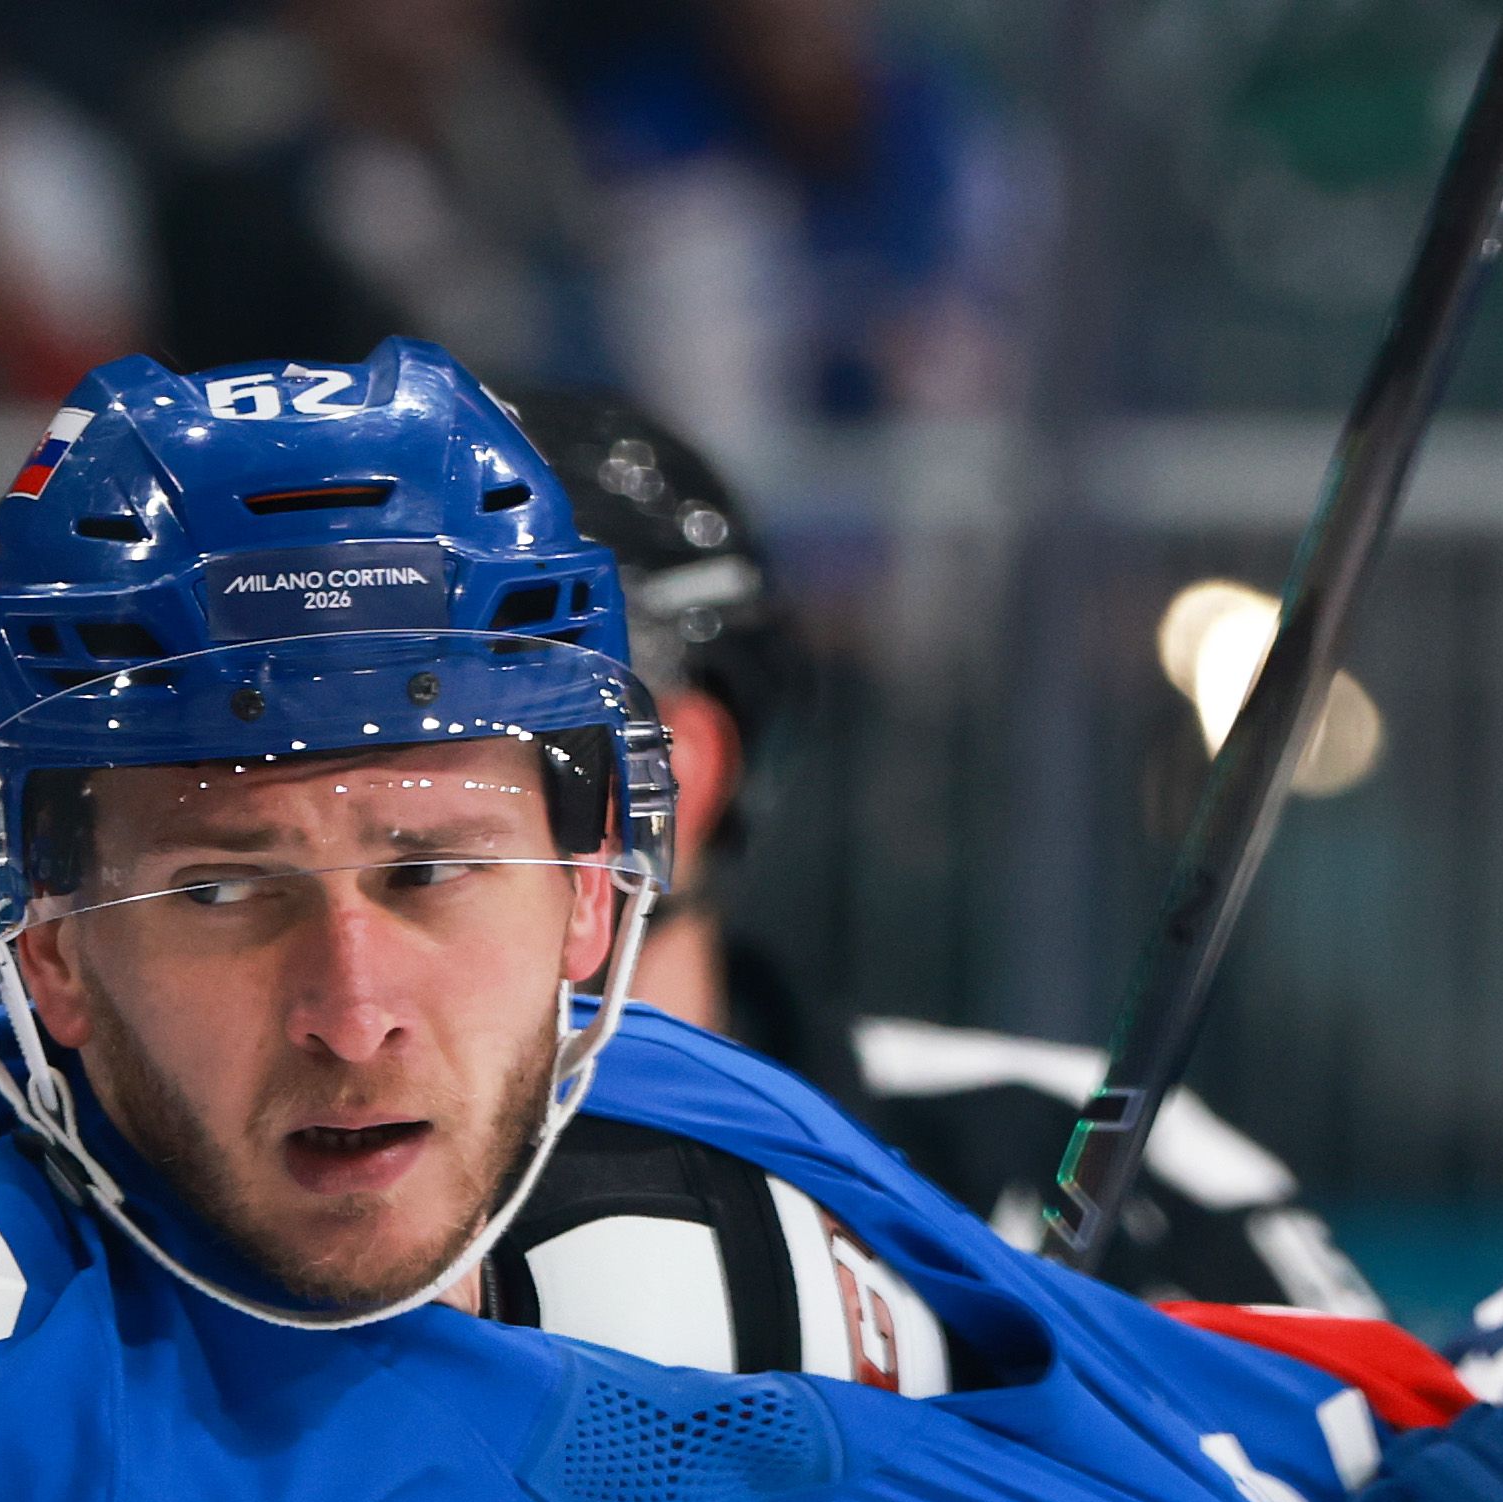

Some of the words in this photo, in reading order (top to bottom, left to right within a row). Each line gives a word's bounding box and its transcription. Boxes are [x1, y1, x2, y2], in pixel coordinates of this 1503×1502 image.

[205, 363, 368, 420] 52
[223, 571, 324, 595] MILANO
[327, 566, 430, 589] CORTINA
[304, 590, 352, 610] 2026
